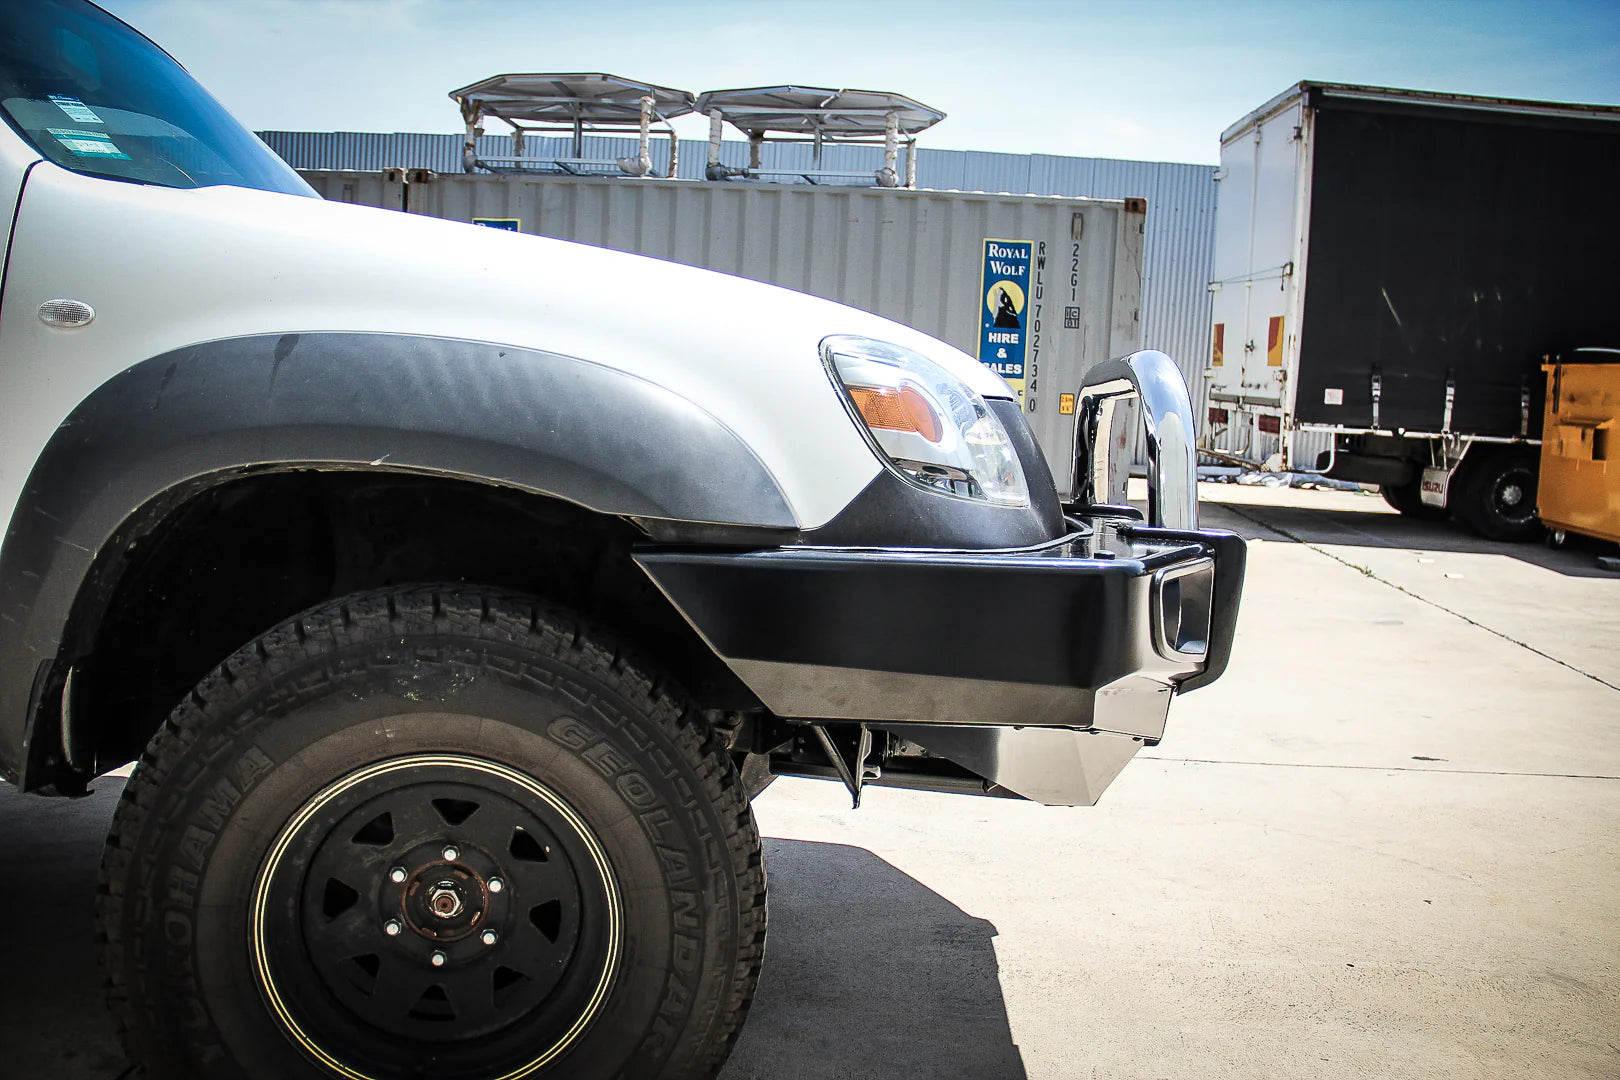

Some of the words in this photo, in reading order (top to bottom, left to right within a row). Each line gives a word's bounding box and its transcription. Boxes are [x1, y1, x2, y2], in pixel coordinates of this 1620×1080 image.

[988, 243, 1028, 259] ROYAL
[990, 260, 1026, 276] WOLF
[1036, 241, 1046, 300] RWLU
[1070, 243, 1079, 301] 22G1
[988, 332, 1019, 344] HIRE
[996, 347, 1007, 359] &
